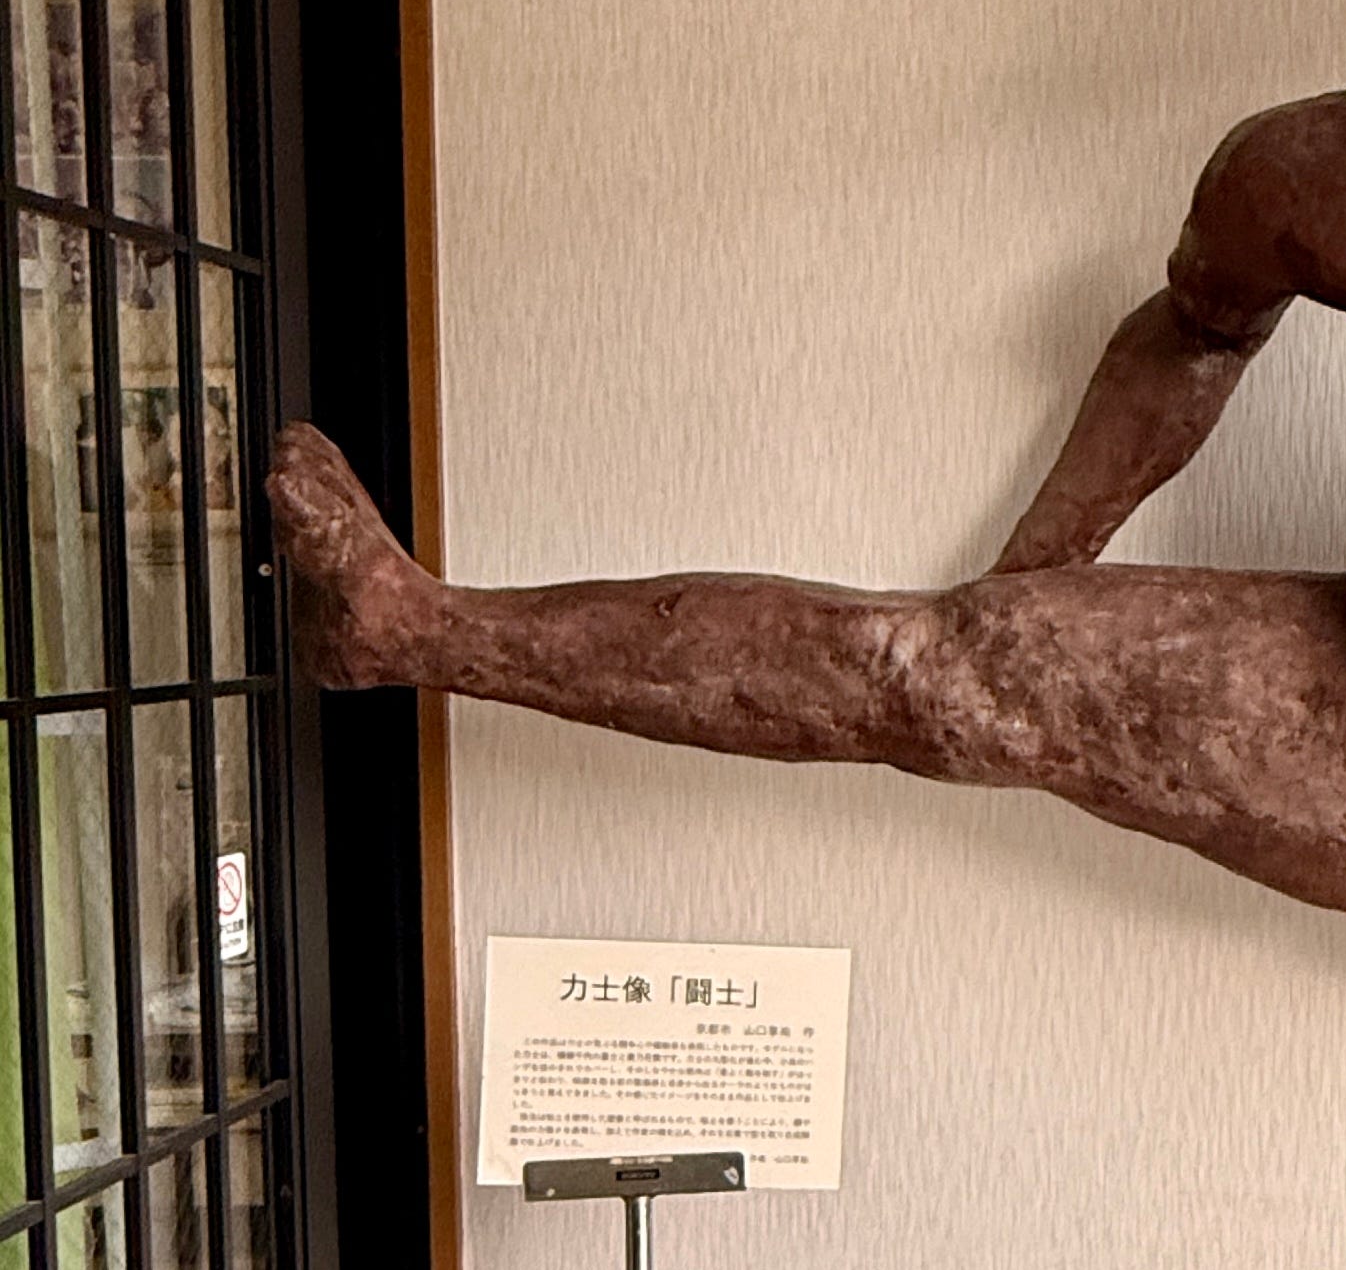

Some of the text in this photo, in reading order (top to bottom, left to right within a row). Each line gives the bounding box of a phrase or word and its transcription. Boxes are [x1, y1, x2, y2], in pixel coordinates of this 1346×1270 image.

[560, 973, 758, 1009] 力士像「闘士」
